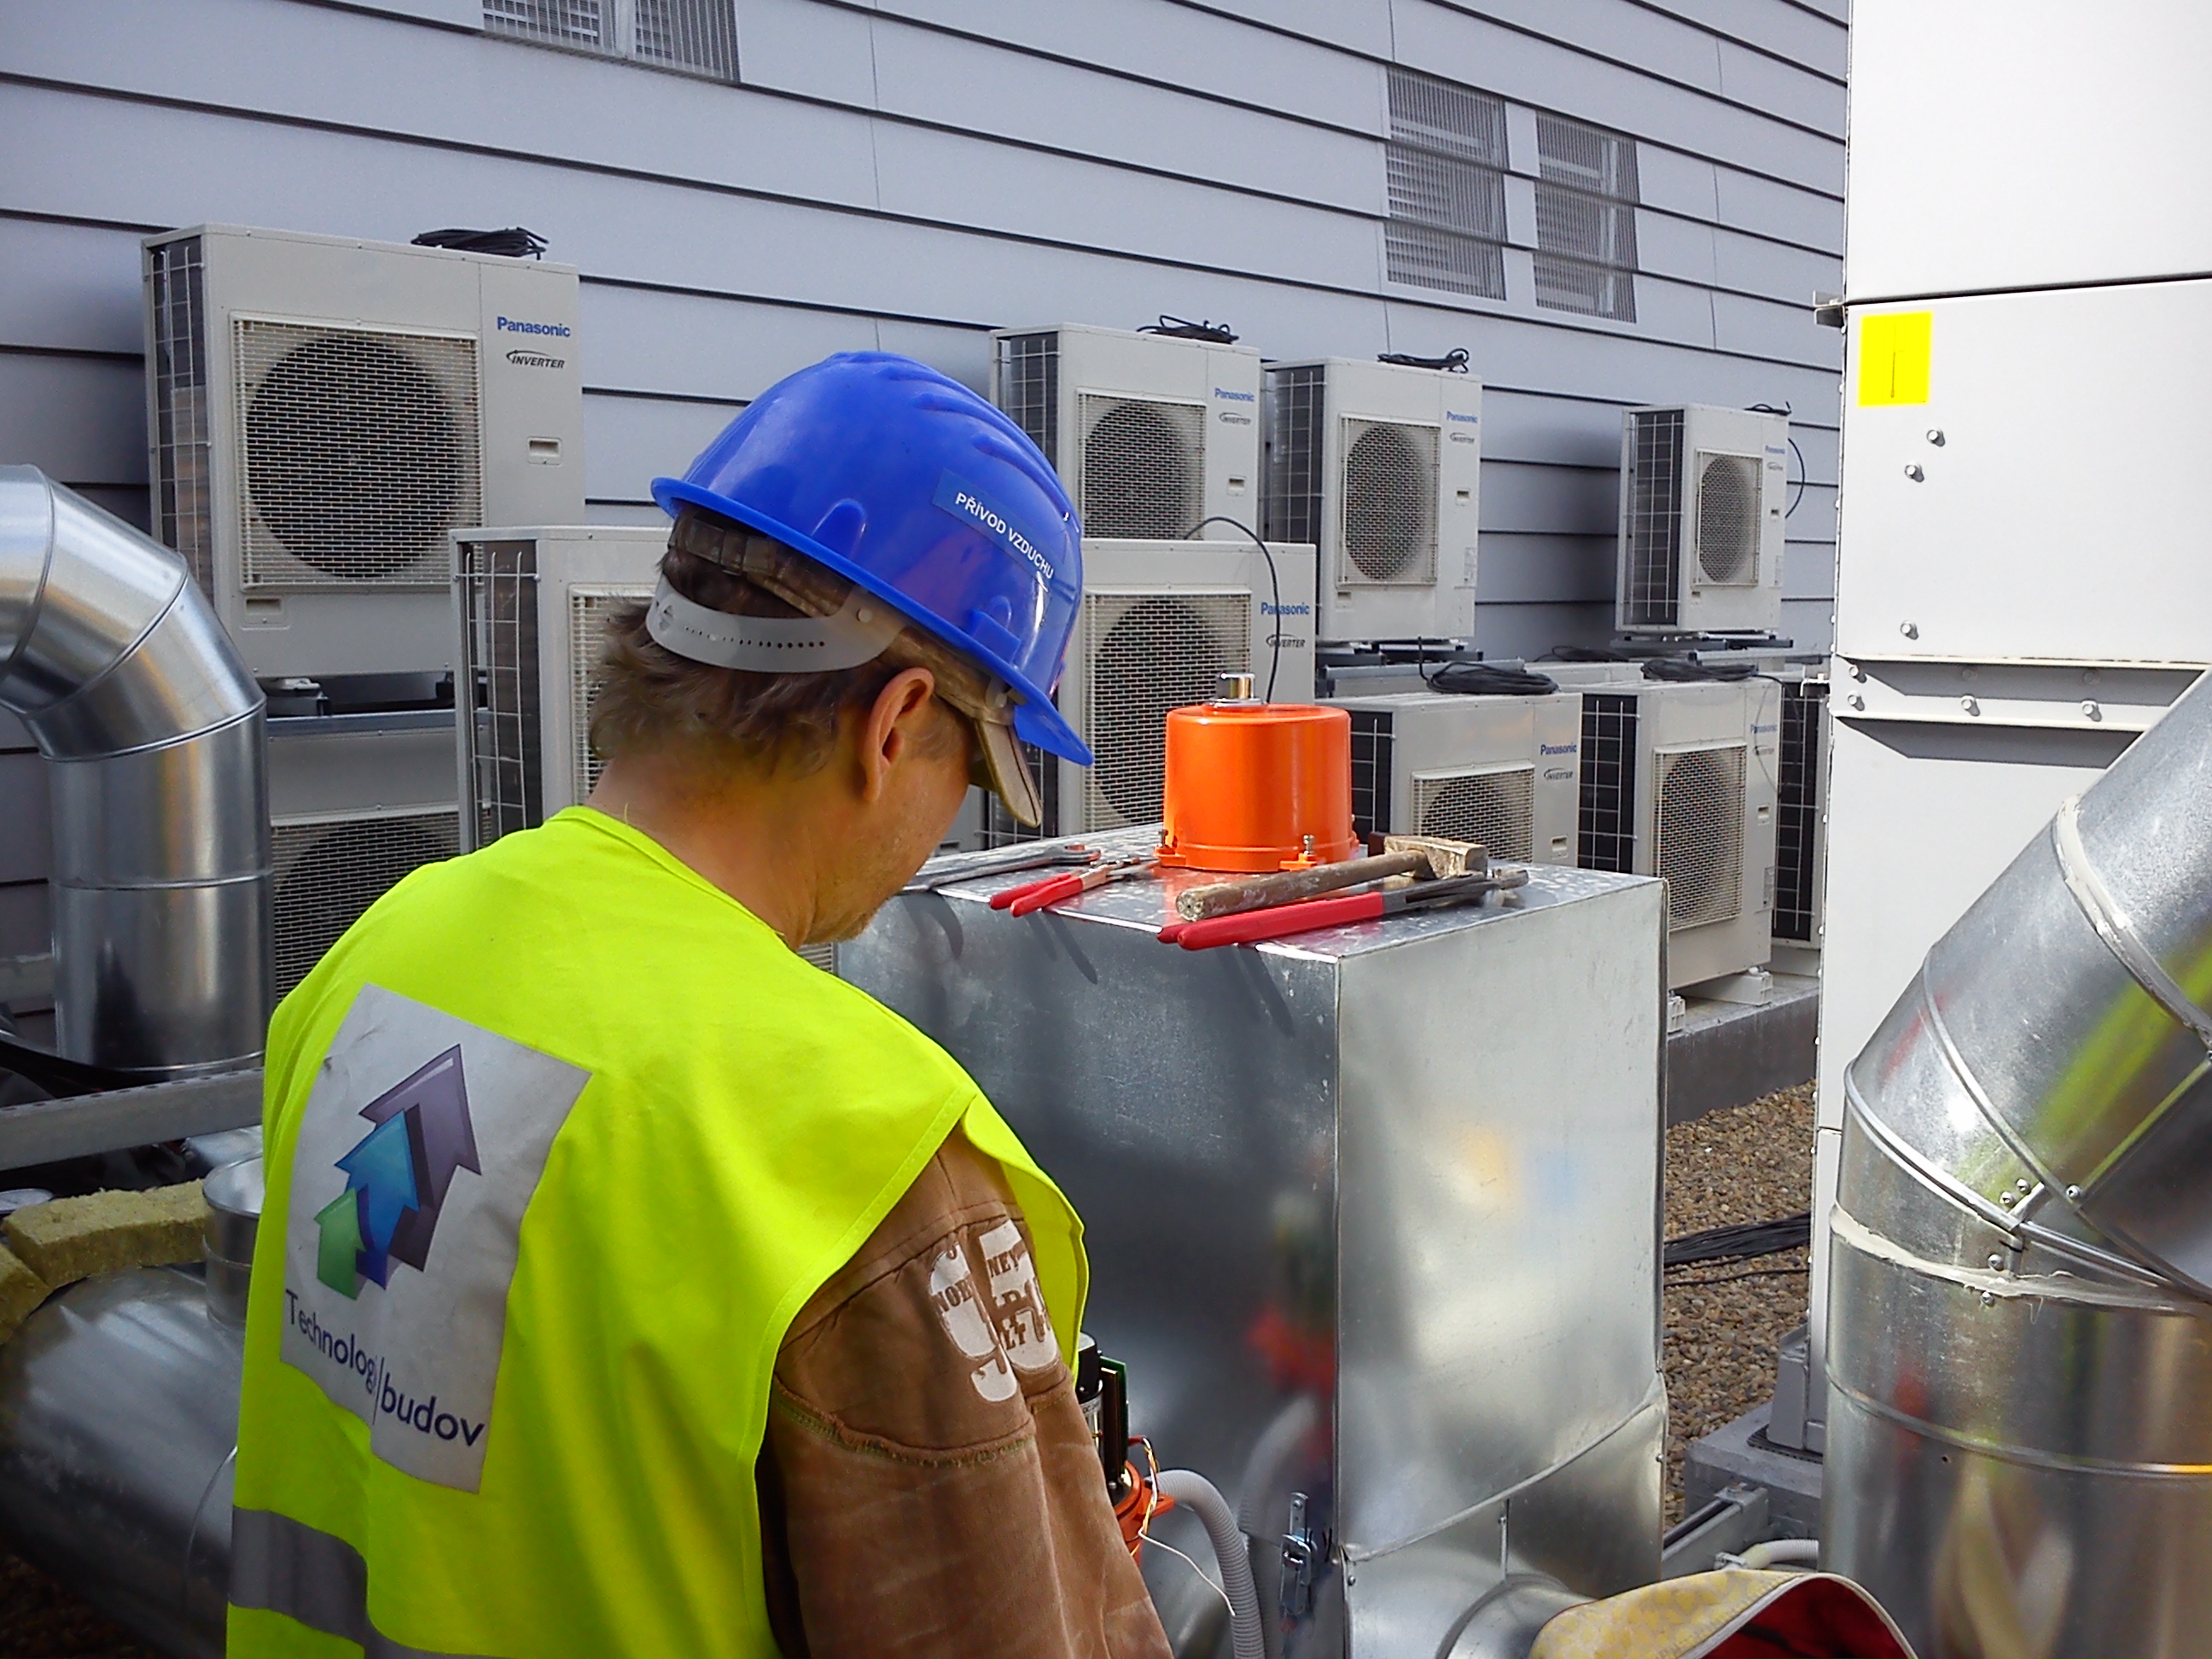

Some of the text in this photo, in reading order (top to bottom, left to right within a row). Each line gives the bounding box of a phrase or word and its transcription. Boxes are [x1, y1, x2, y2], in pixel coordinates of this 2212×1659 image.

[497, 316, 571, 338] Panasonic
[510, 353, 566, 369] INVERTER
[1214, 387, 1254, 402] Panasonic
[955, 492, 1055, 579] PŘÍVOD VZDUCHU
[1540, 742, 1577, 755] Panasonic
[381, 1371, 486, 1447] budov
